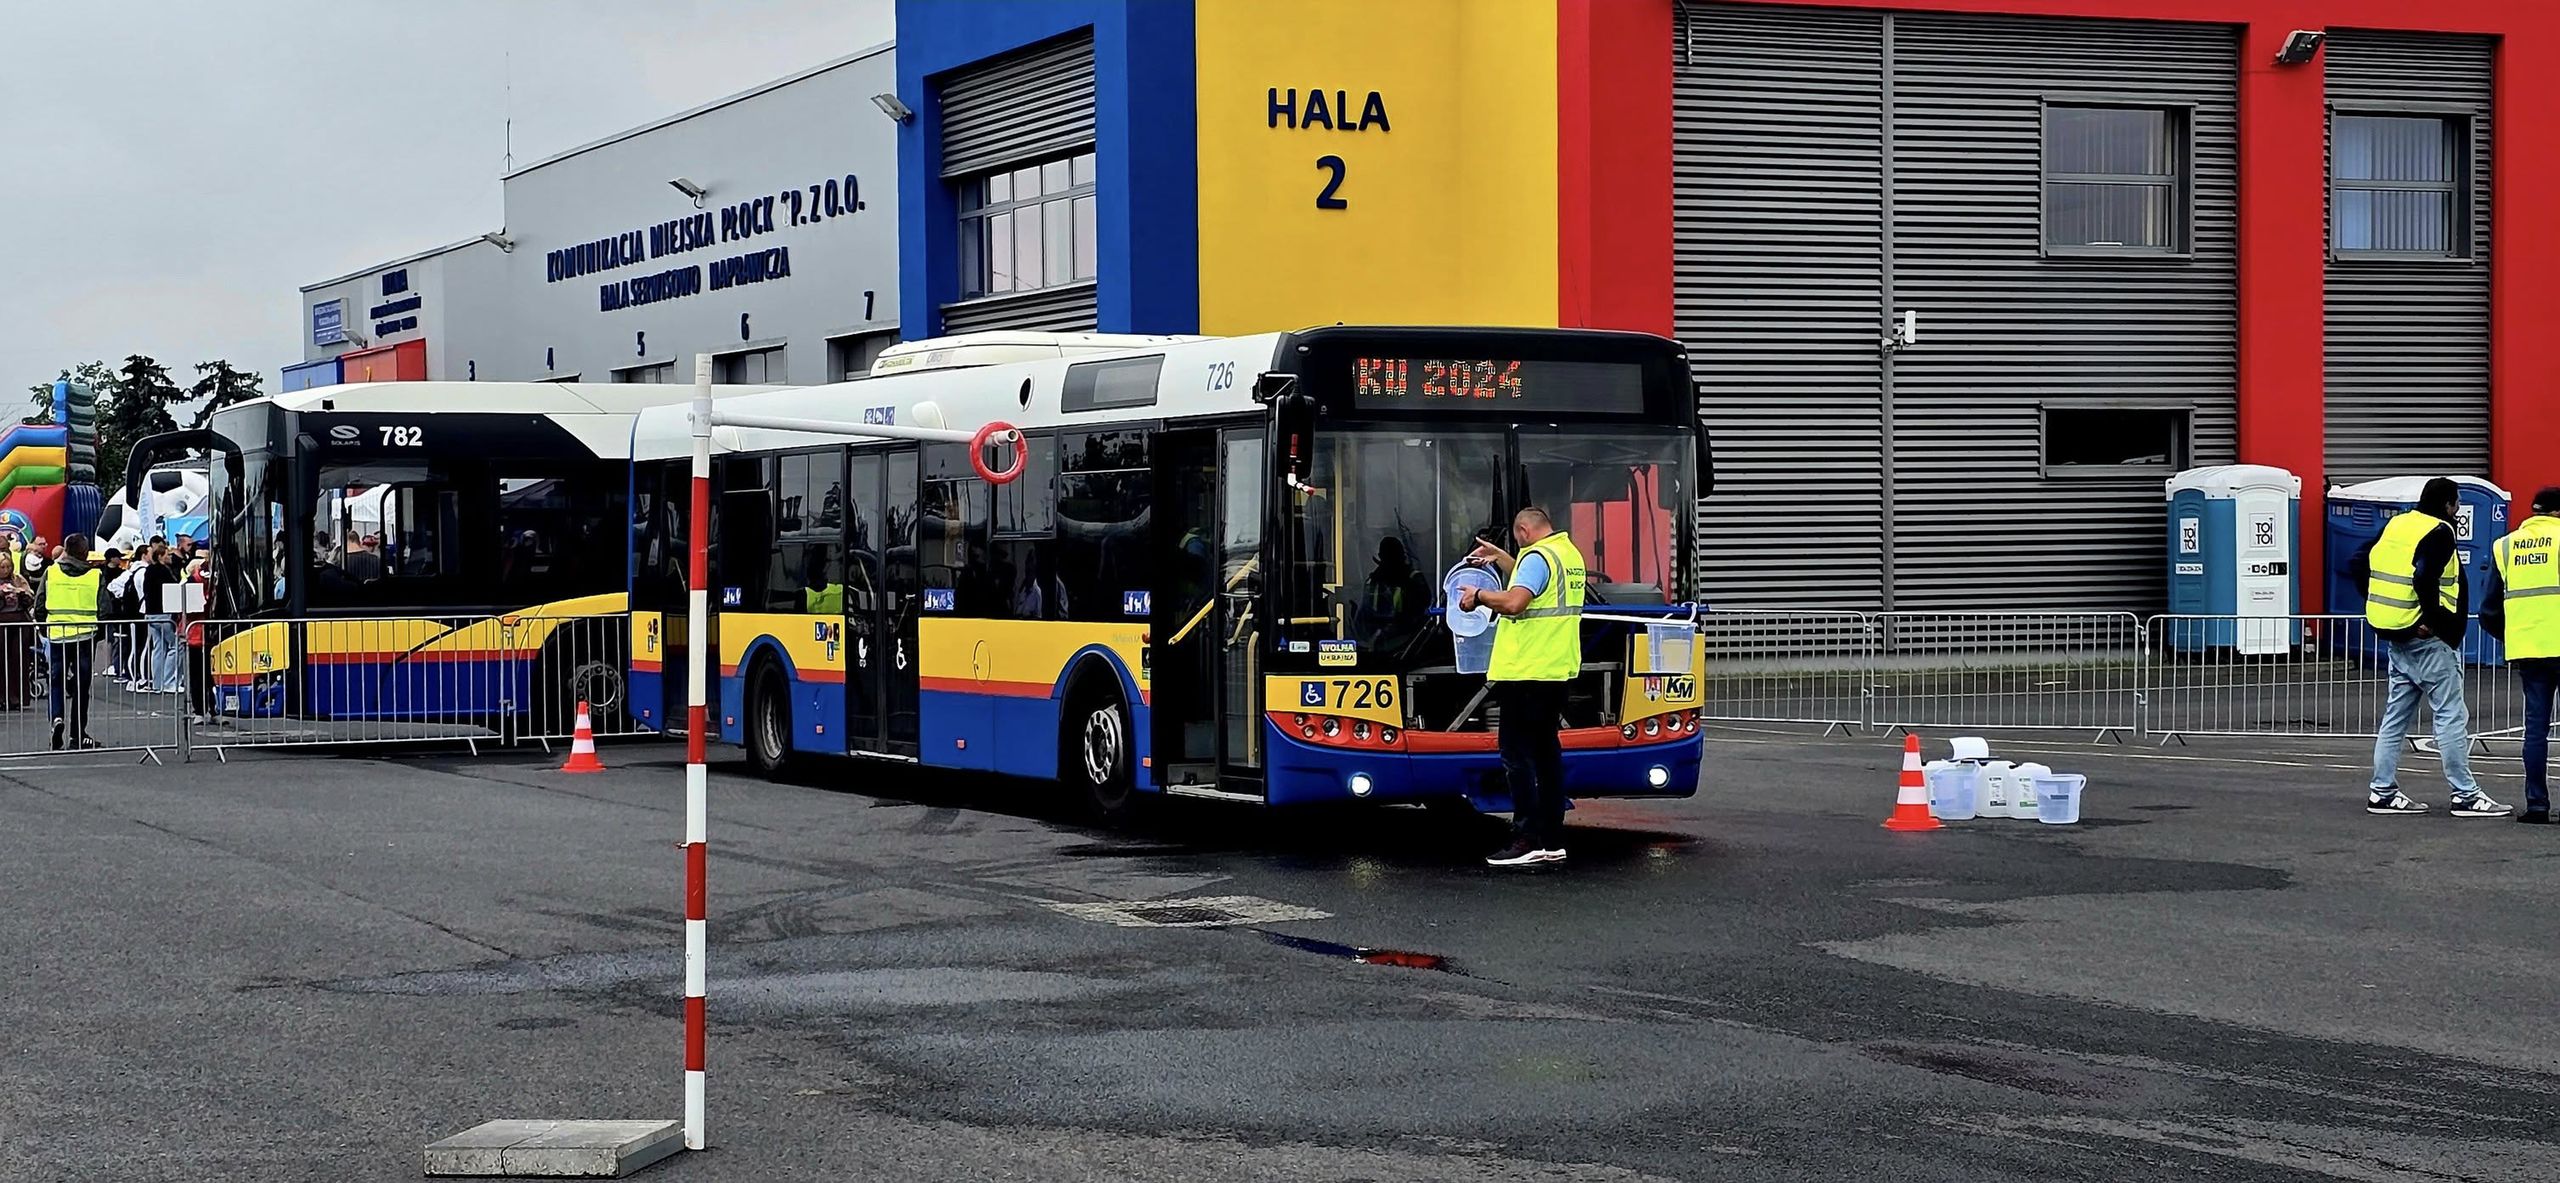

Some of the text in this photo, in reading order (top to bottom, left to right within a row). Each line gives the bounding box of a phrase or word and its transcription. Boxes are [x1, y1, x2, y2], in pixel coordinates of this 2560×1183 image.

[1268, 88, 1391, 132] HALA
[1315, 155, 1348, 210] 2
[547, 230, 645, 282] KOMUNIKACJA
[650, 212, 716, 259] MIEJSKA
[721, 195, 774, 242] PŁOCK
[863, 291, 874, 321] 7
[741, 312, 750, 341] 6
[637, 331, 646, 357] 5
[1206, 361, 1235, 392] 726
[1423, 358, 1522, 400] 2024
[379, 426, 423, 446] 782
[2513, 537, 2552, 549] NADZOR
[2514, 553, 2548, 566] RUCHU
[1321, 643, 1355, 652] WOLNA
[1332, 680, 1393, 709] 726
[1666, 677, 1693, 699] KM
